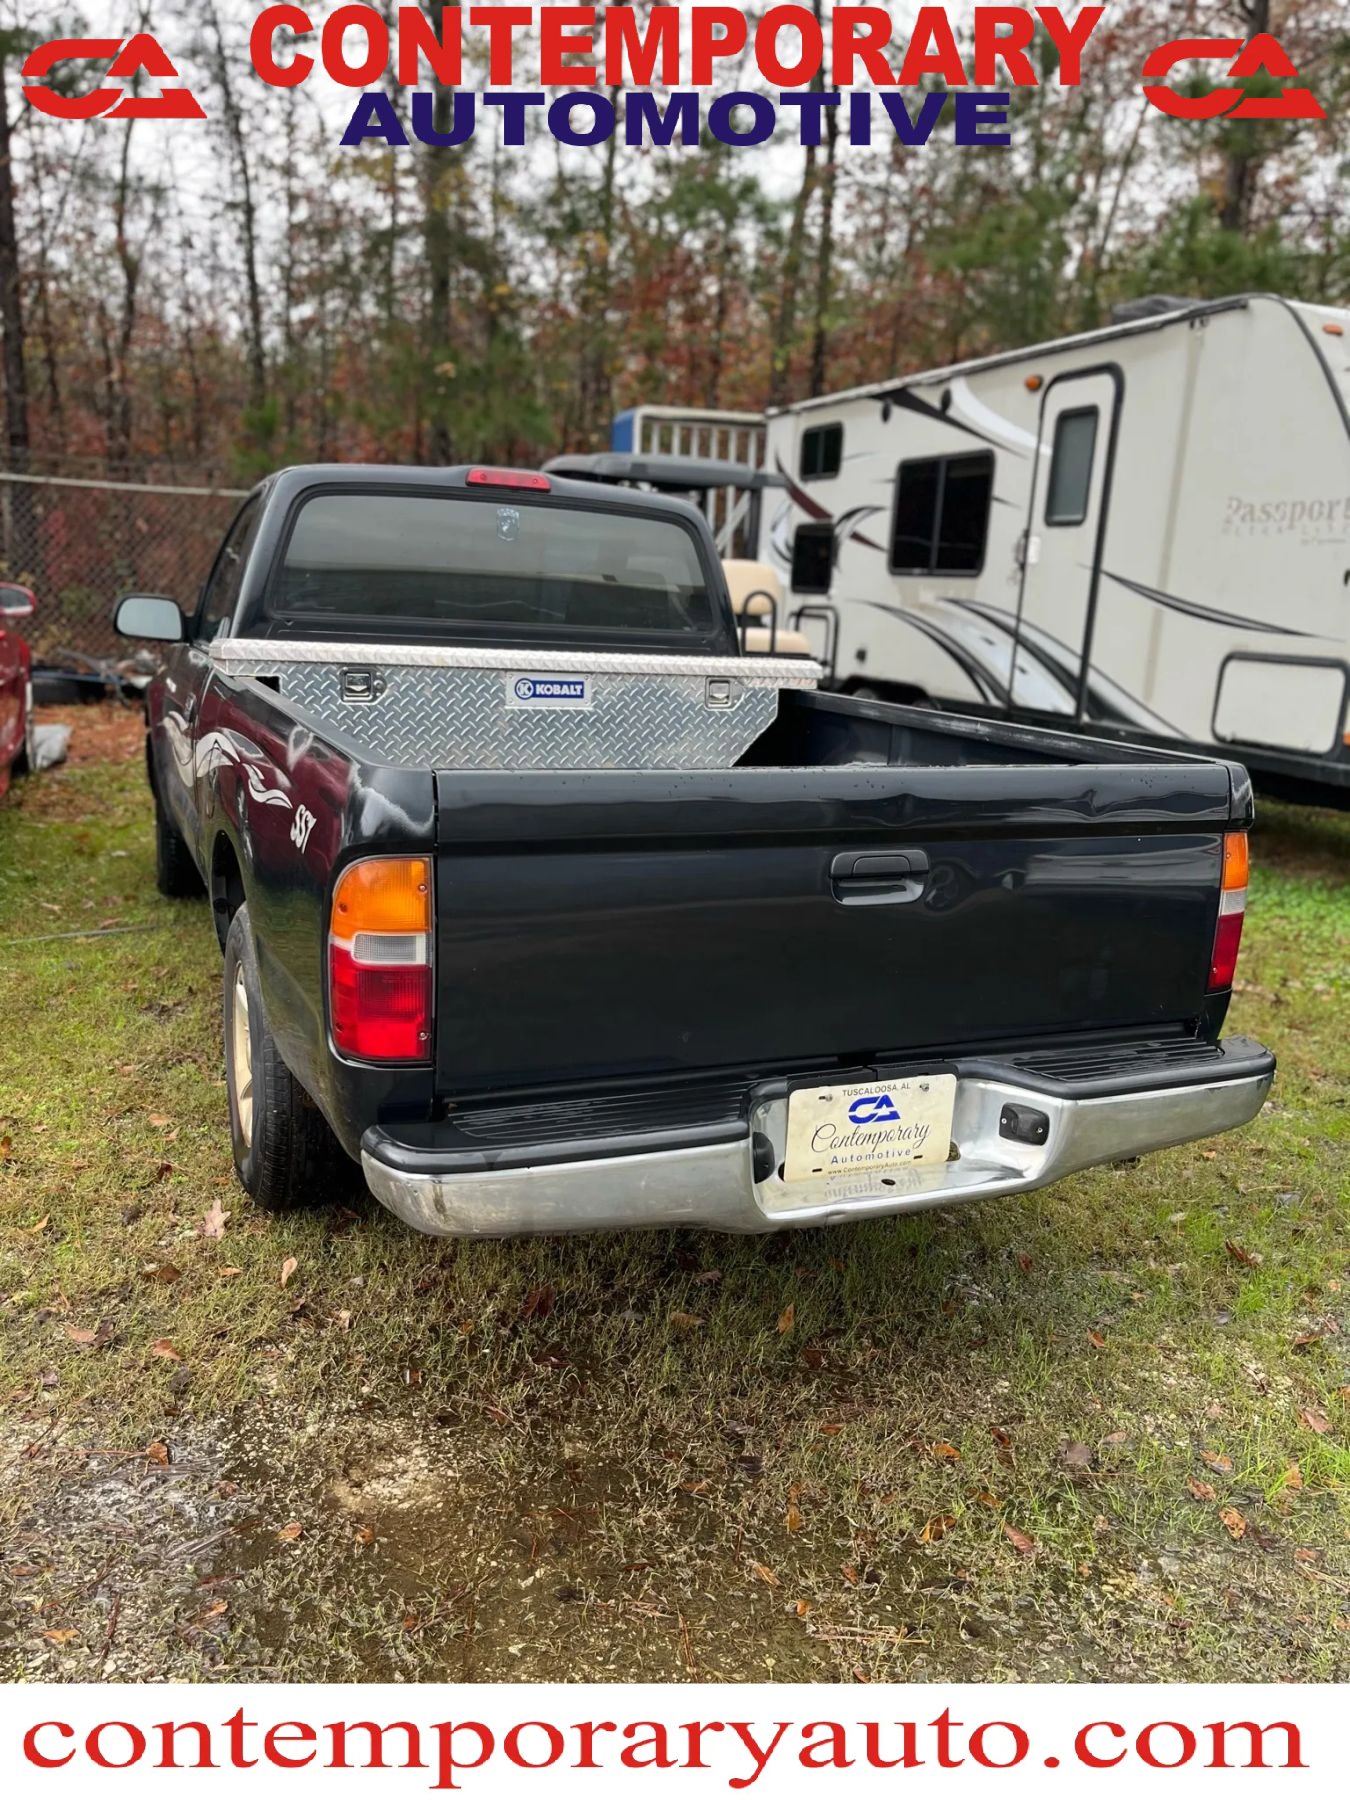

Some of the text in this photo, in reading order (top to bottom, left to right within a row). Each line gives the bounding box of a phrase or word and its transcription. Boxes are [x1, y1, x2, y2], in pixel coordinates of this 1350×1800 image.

[535, 684, 582, 695] KOBALT
[811, 1123, 931, 1153] Contemporary
[830, 1149, 912, 1165] Automotive
